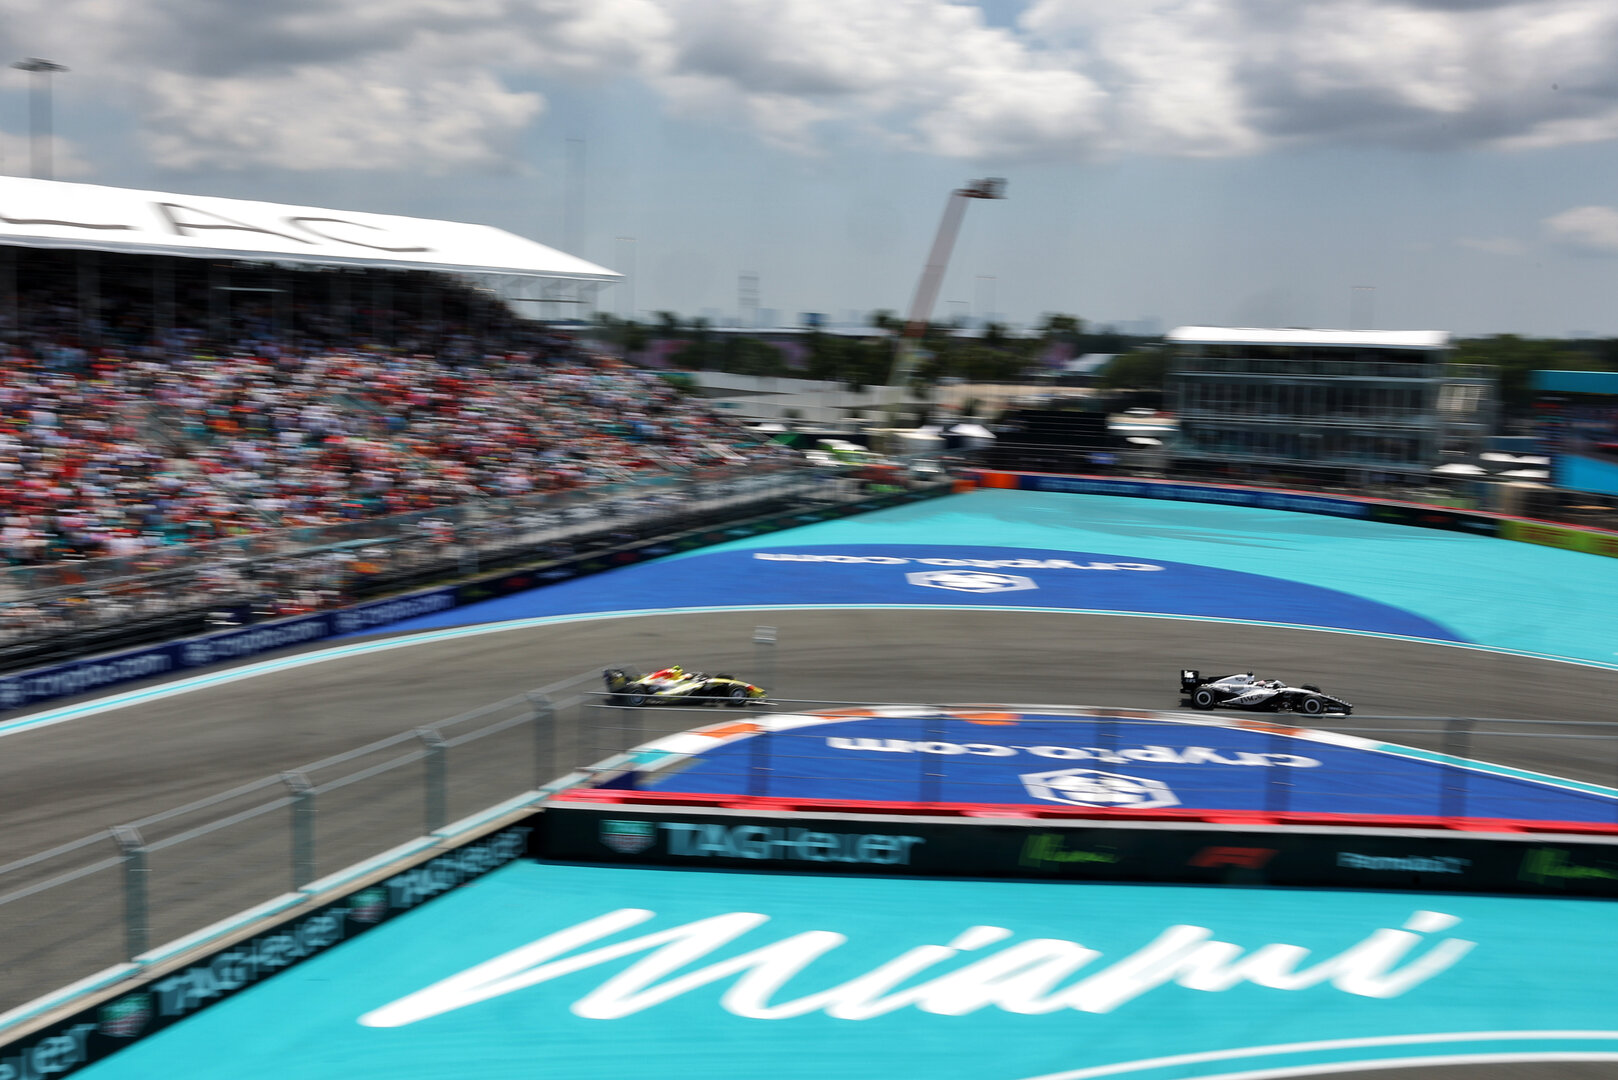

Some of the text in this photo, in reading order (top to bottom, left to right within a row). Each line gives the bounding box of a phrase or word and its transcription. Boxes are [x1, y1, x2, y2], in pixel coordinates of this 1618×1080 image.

[753, 552, 1166, 571] crypto.com
[826, 736, 1322, 768] crypto.com
[358, 908, 1478, 1029] Miami
